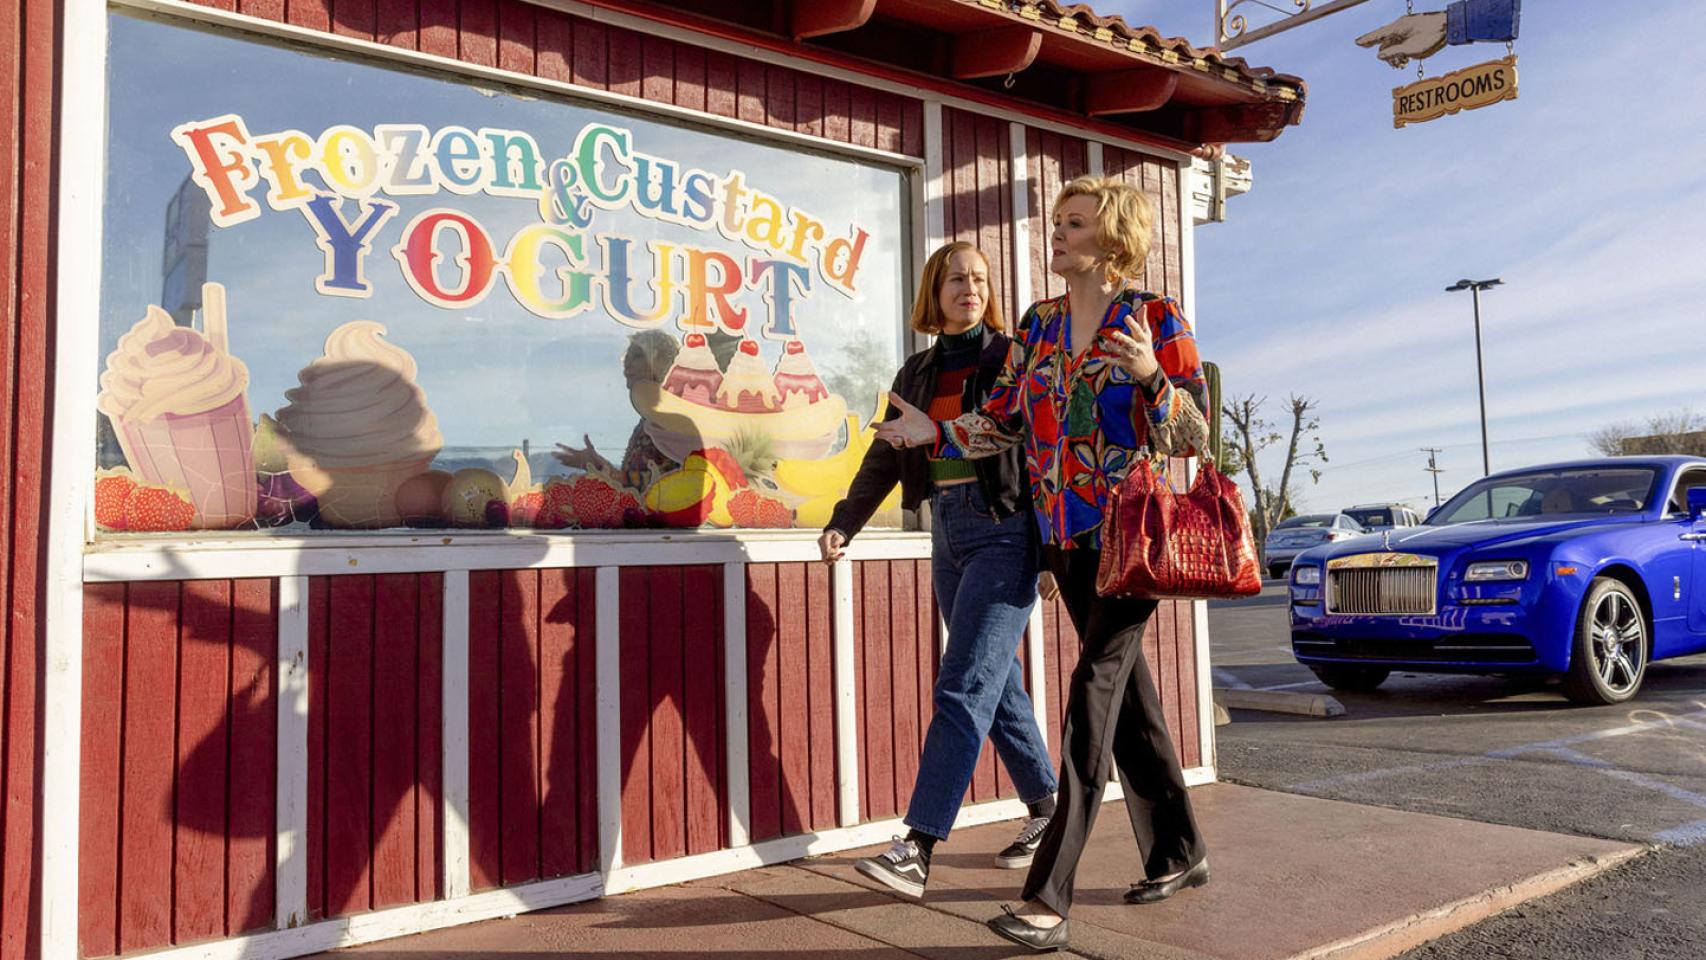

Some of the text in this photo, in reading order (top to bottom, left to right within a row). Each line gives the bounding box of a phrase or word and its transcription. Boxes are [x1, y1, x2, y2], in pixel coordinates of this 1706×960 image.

[1399, 69, 1505, 115] RESTROOMS
[181, 119, 871, 292] Frozen & Custard
[306, 194, 811, 337] YOGURT
